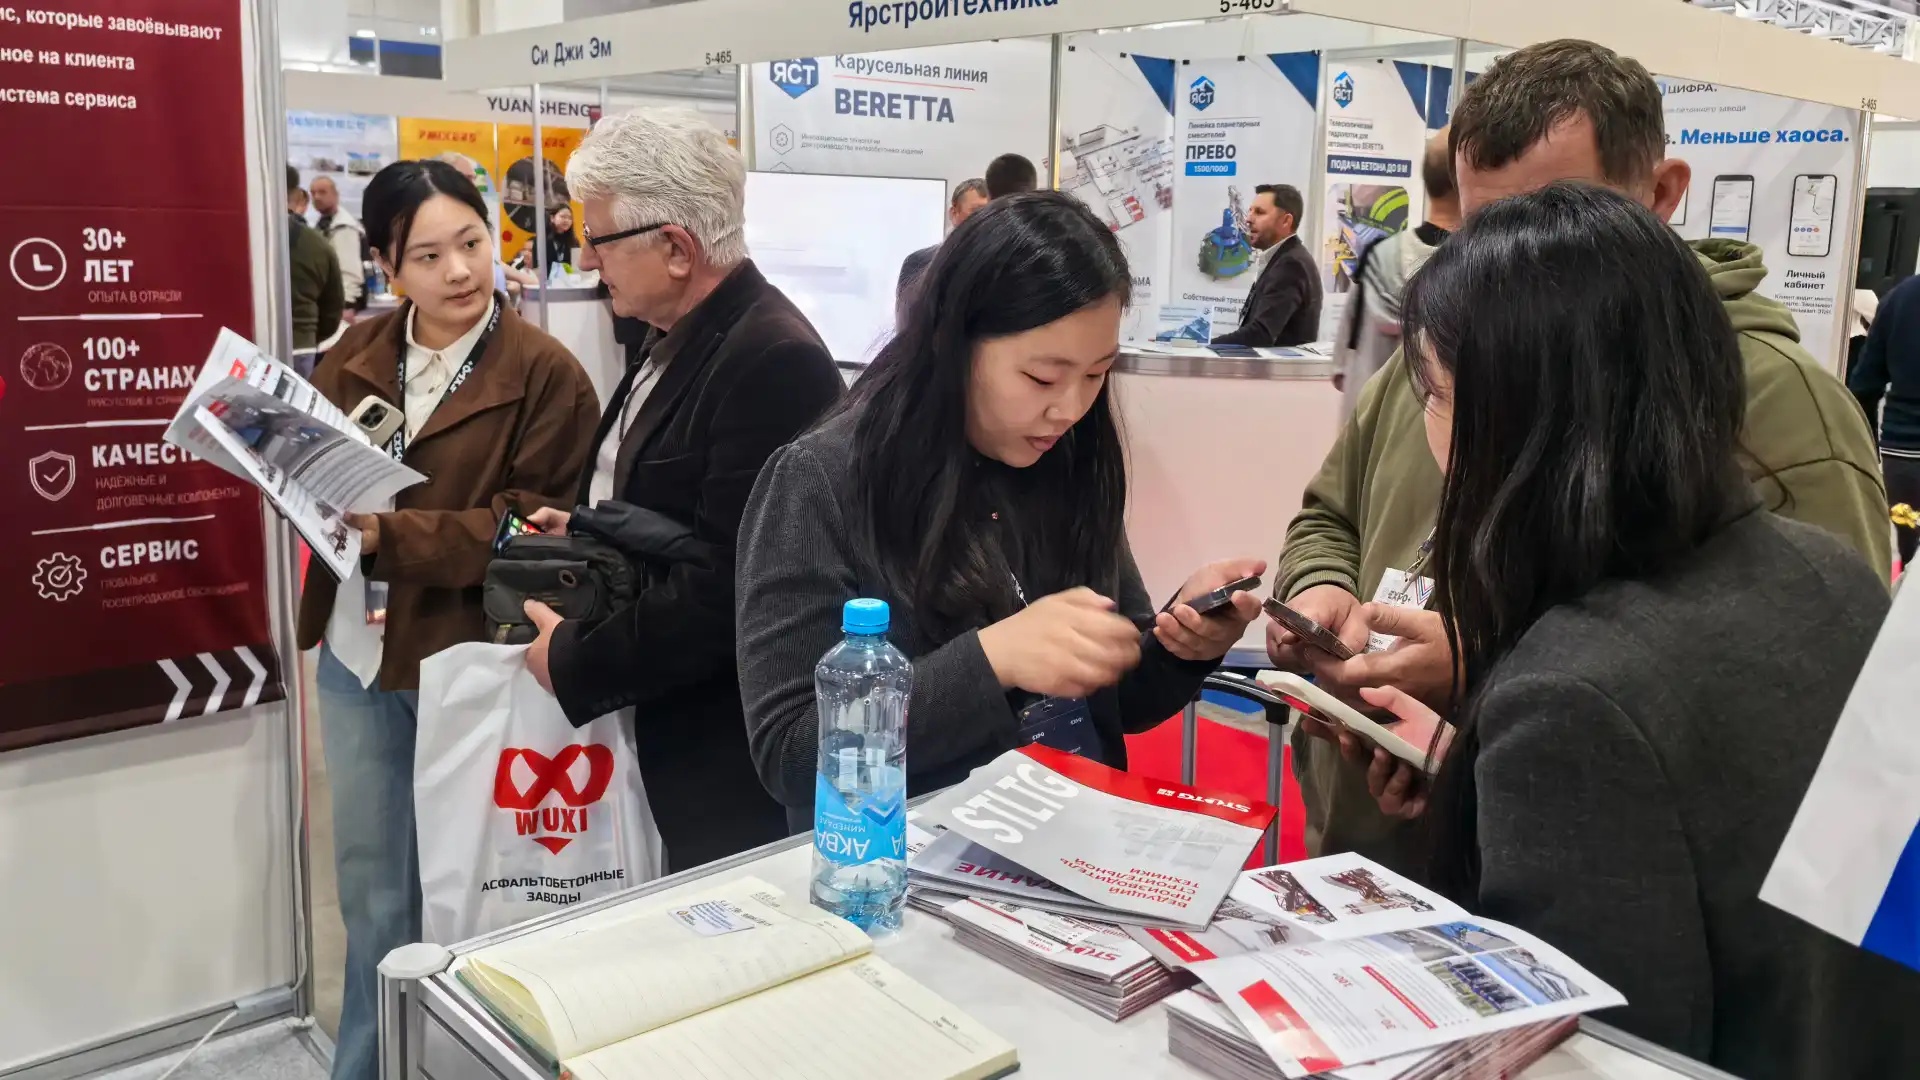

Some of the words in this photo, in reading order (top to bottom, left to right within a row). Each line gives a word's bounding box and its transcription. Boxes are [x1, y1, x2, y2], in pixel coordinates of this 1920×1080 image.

[26, 9, 103, 30] которые
[108, 16, 223, 40] завоёвывают
[38, 48, 60, 65] на
[65, 52, 136, 71] клиента
[531, 45, 549, 66] Си
[554, 40, 583, 66] Джи
[589, 37, 612, 59] Эм
[705, 50, 732, 65] 5-465
[773, 62, 816, 85] ЯСТ
[834, 53, 941, 78] Карусельная
[944, 66, 989, 83] линия
[64, 91, 137, 110] сервиса
[834, 88, 955, 123] BERETTA
[1191, 92, 1212, 104] ЯСТ
[1335, 89, 1352, 101] ЯСТ
[1680, 128, 1770, 145] Меньше
[1775, 128, 1850, 144] хаоса.
[1186, 144, 1236, 160] ПРЕВО
[83, 227, 126, 251] 30+
[83, 259, 134, 283] ЛЕТ
[1785, 269, 1826, 280] Личный
[88, 290, 128, 303] ОПЫТА
[129, 290, 138, 303] В
[1783, 281, 1826, 290] кабинет
[82, 336, 141, 361] 100+
[84, 364, 197, 392] СТРАНАХ
[159, 474, 168, 486] И
[100, 538, 200, 569] СЕРВИС
[514, 807, 589, 836] WUXI
[815, 825, 871, 860] АКВА
[481, 869, 625, 892] АСФАЛЬТОБЕТОННЫЕ
[1059, 857, 1192, 902] ПРОИЗВОДИТЕЛЬ
[1075, 857, 1197, 895] СТРОИТЕЛЬНОЙ
[1130, 866, 1200, 888] ТЕХНИКИ
[526, 891, 581, 905] ЗАВОДЫ
[1108, 885, 1188, 909] ВЕДУЩИЙ
